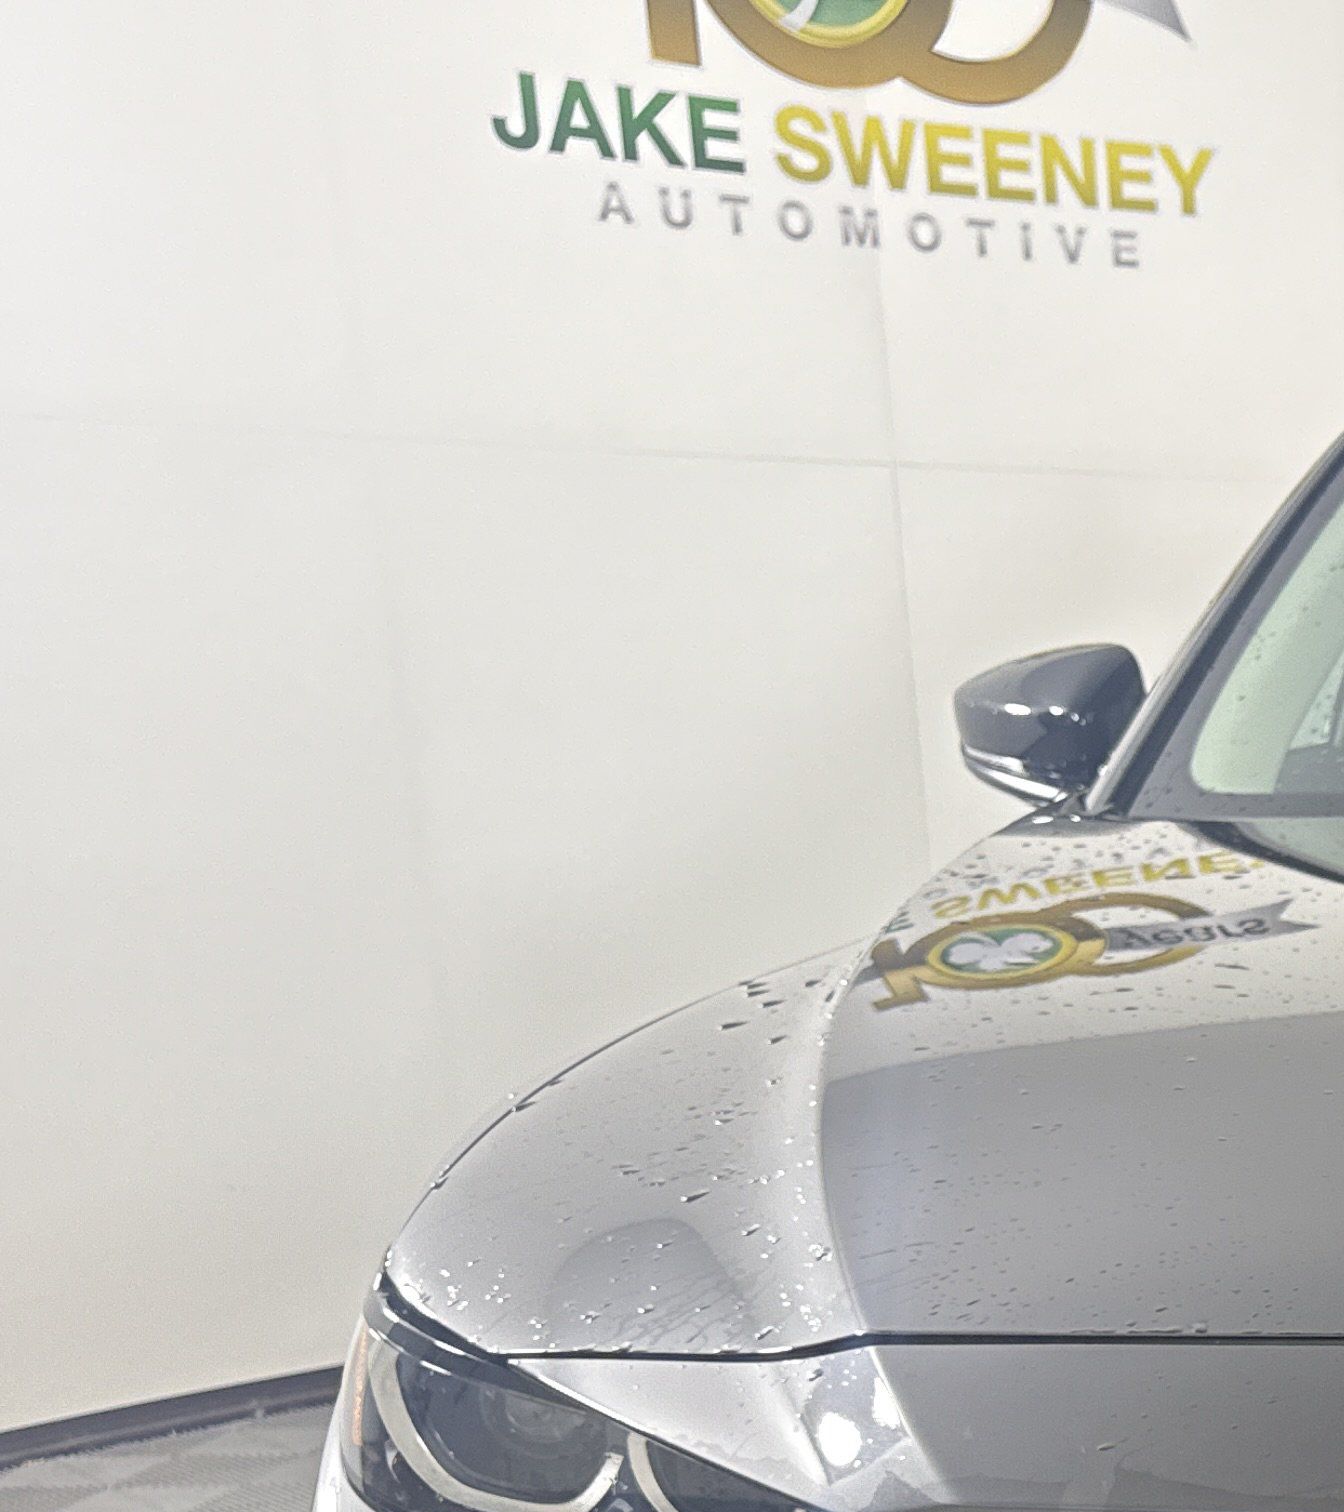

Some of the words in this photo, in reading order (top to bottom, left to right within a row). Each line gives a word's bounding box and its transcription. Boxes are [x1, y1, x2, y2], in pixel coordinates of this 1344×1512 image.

[492, 72, 746, 174] JAKE
[775, 105, 1215, 215] SWEENEY
[598, 182, 1141, 269] AUTOMOTIVE
